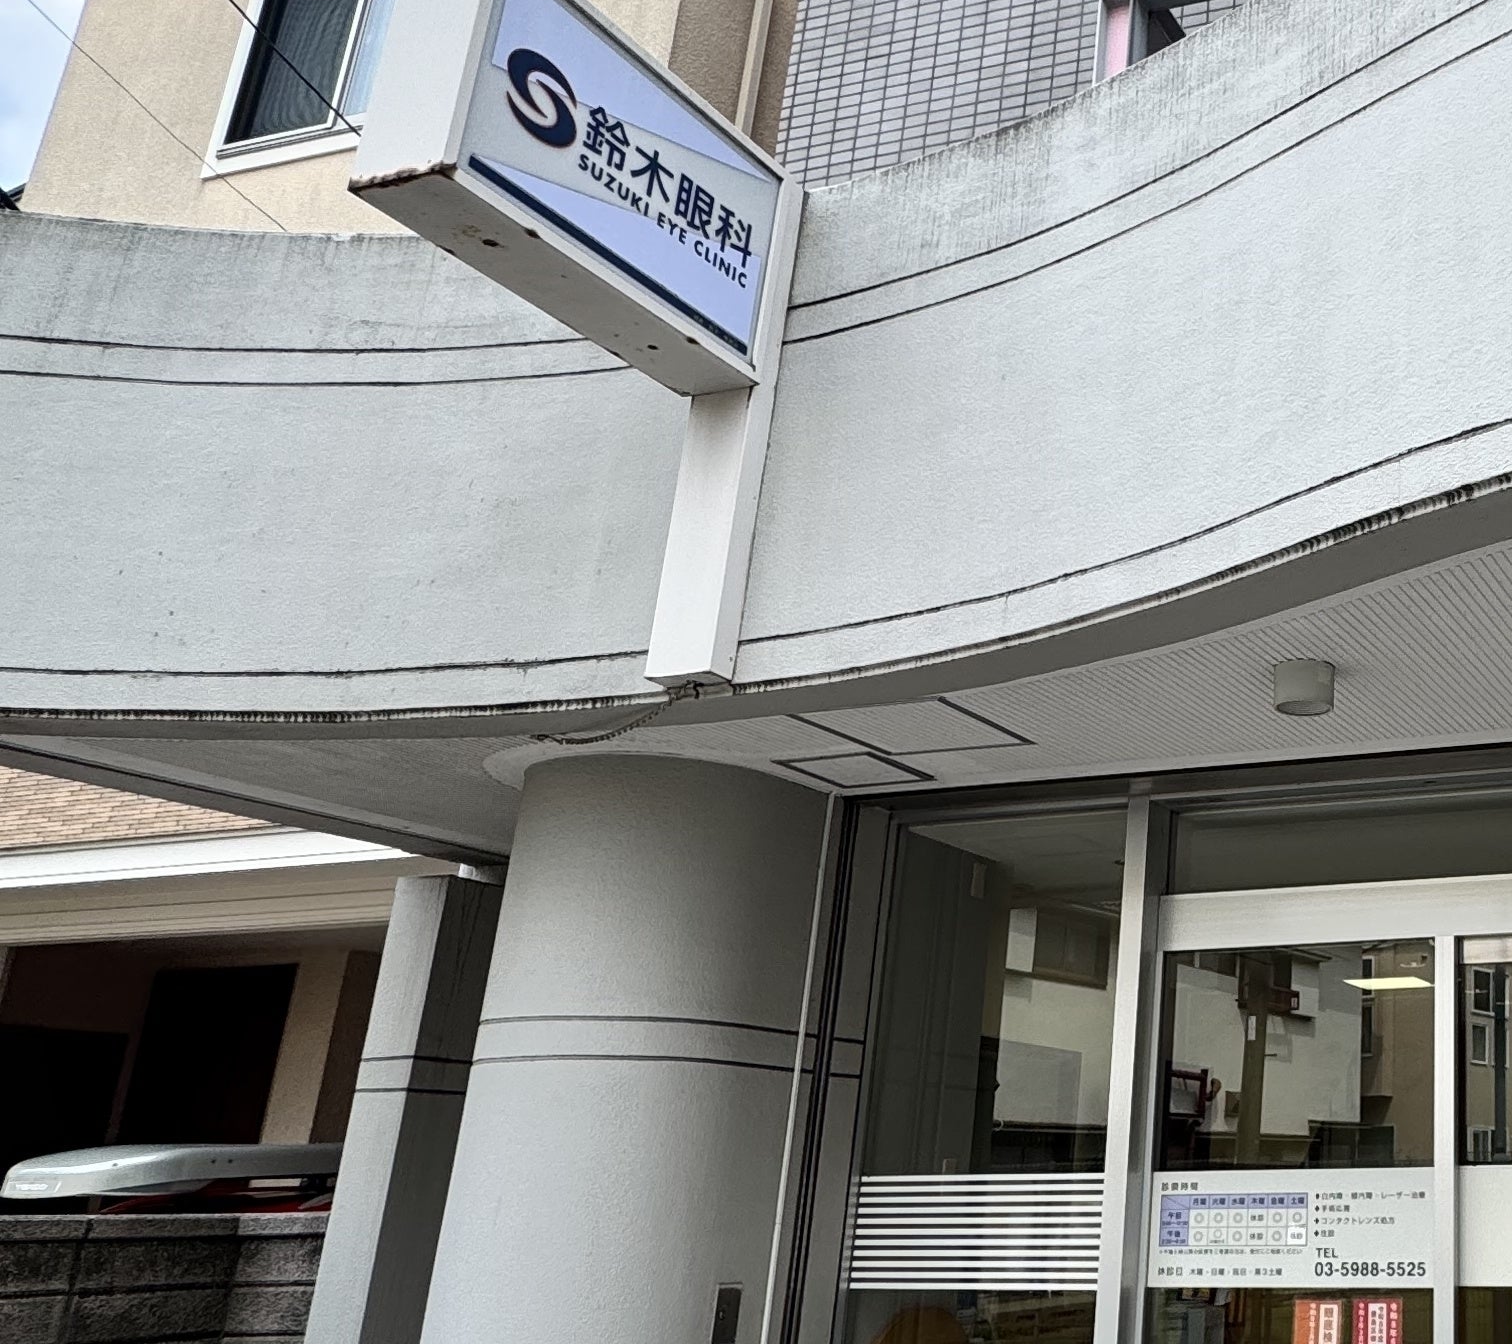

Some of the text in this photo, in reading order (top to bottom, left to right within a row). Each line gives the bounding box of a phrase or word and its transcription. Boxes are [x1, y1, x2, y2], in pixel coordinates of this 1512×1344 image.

[583, 107, 753, 269] 鈴木眼科
[578, 154, 747, 288] SUZUKI EYE CLINIC
[1322, 1216, 1395, 1224] コンタクトレンズ処方
[1315, 1247, 1338, 1258] TEL
[1314, 1262, 1426, 1277] 03-5988-5525
